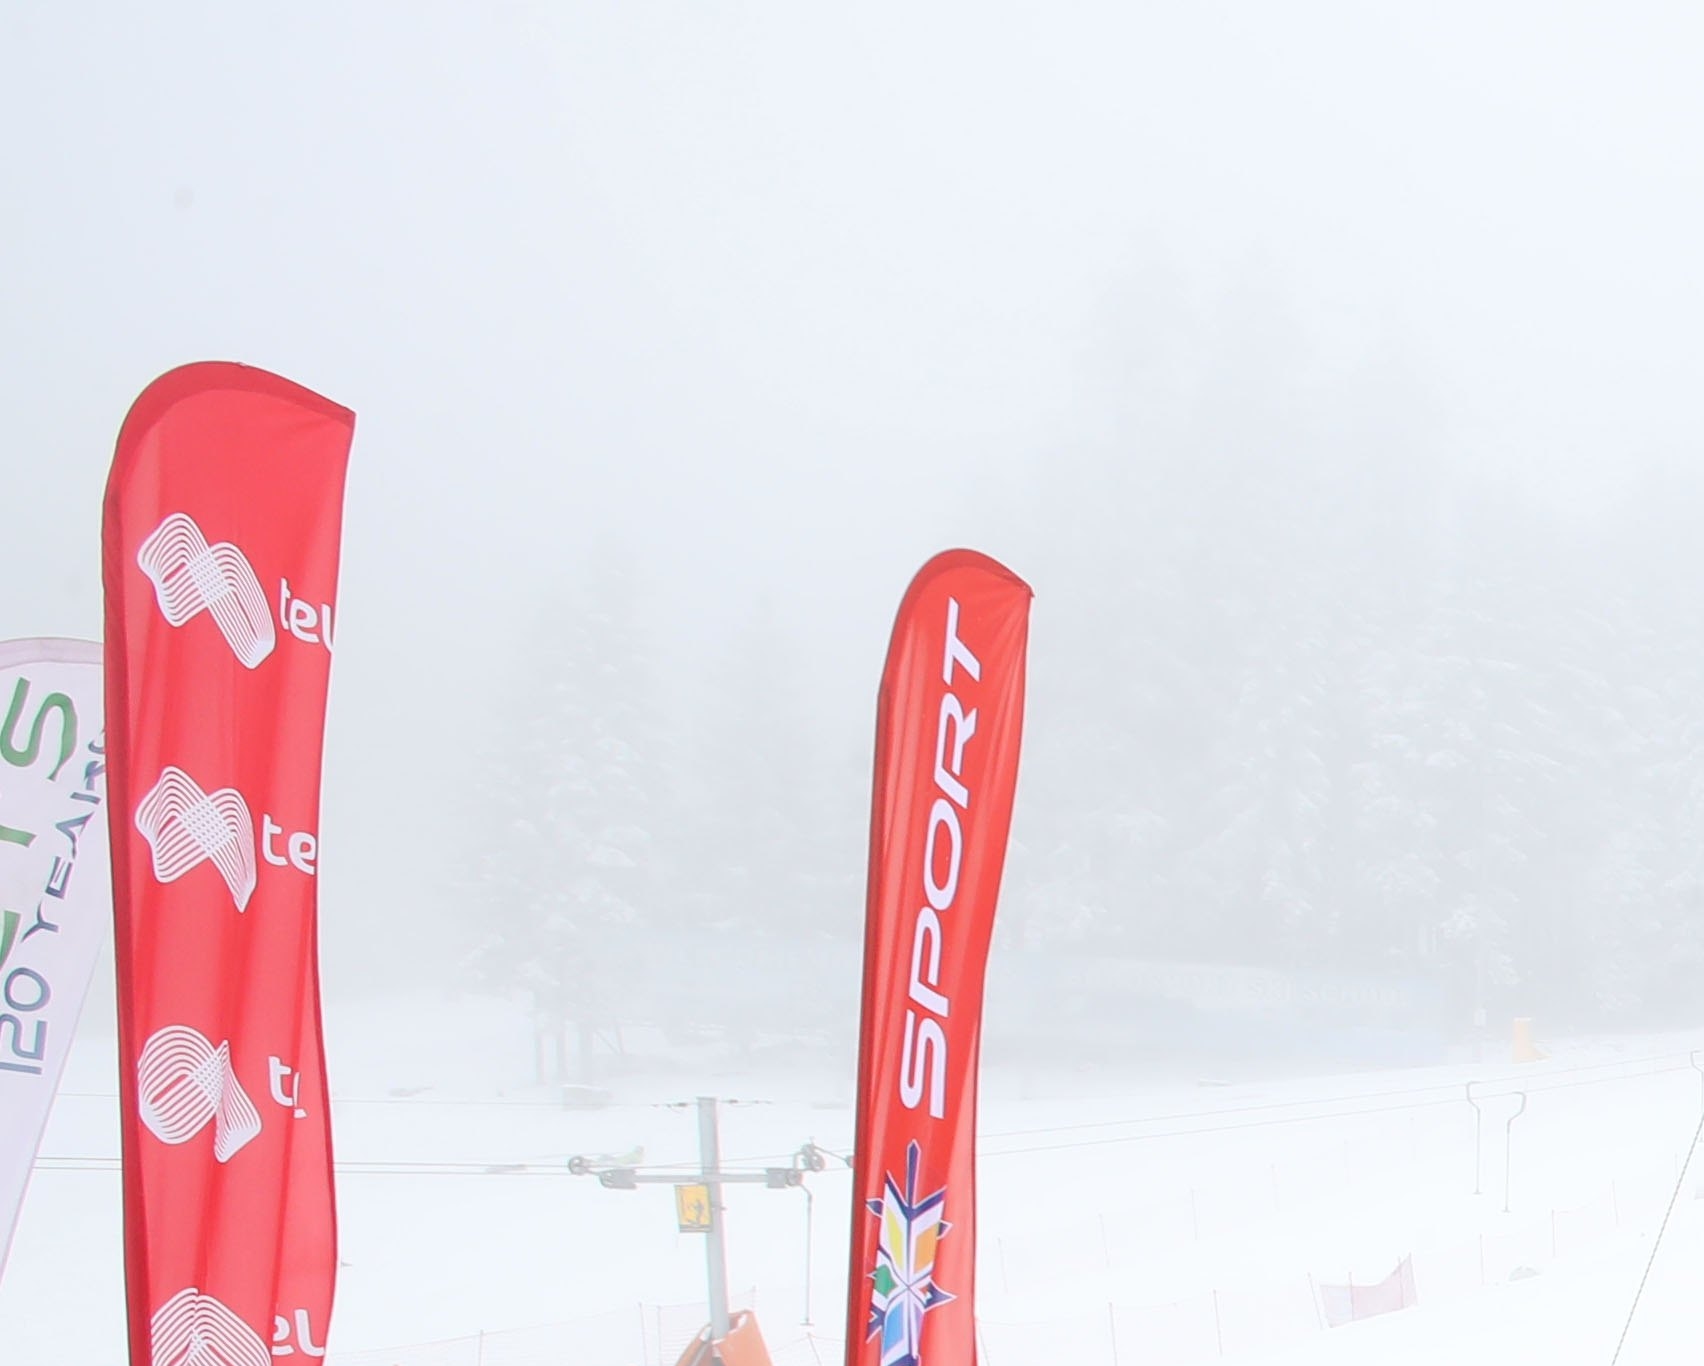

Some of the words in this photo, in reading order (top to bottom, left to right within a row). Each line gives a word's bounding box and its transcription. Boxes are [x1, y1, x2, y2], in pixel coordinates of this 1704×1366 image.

[262, 813, 318, 875] te
[899, 597, 981, 1119] SPORT
[270, 1307, 326, 1357] el
